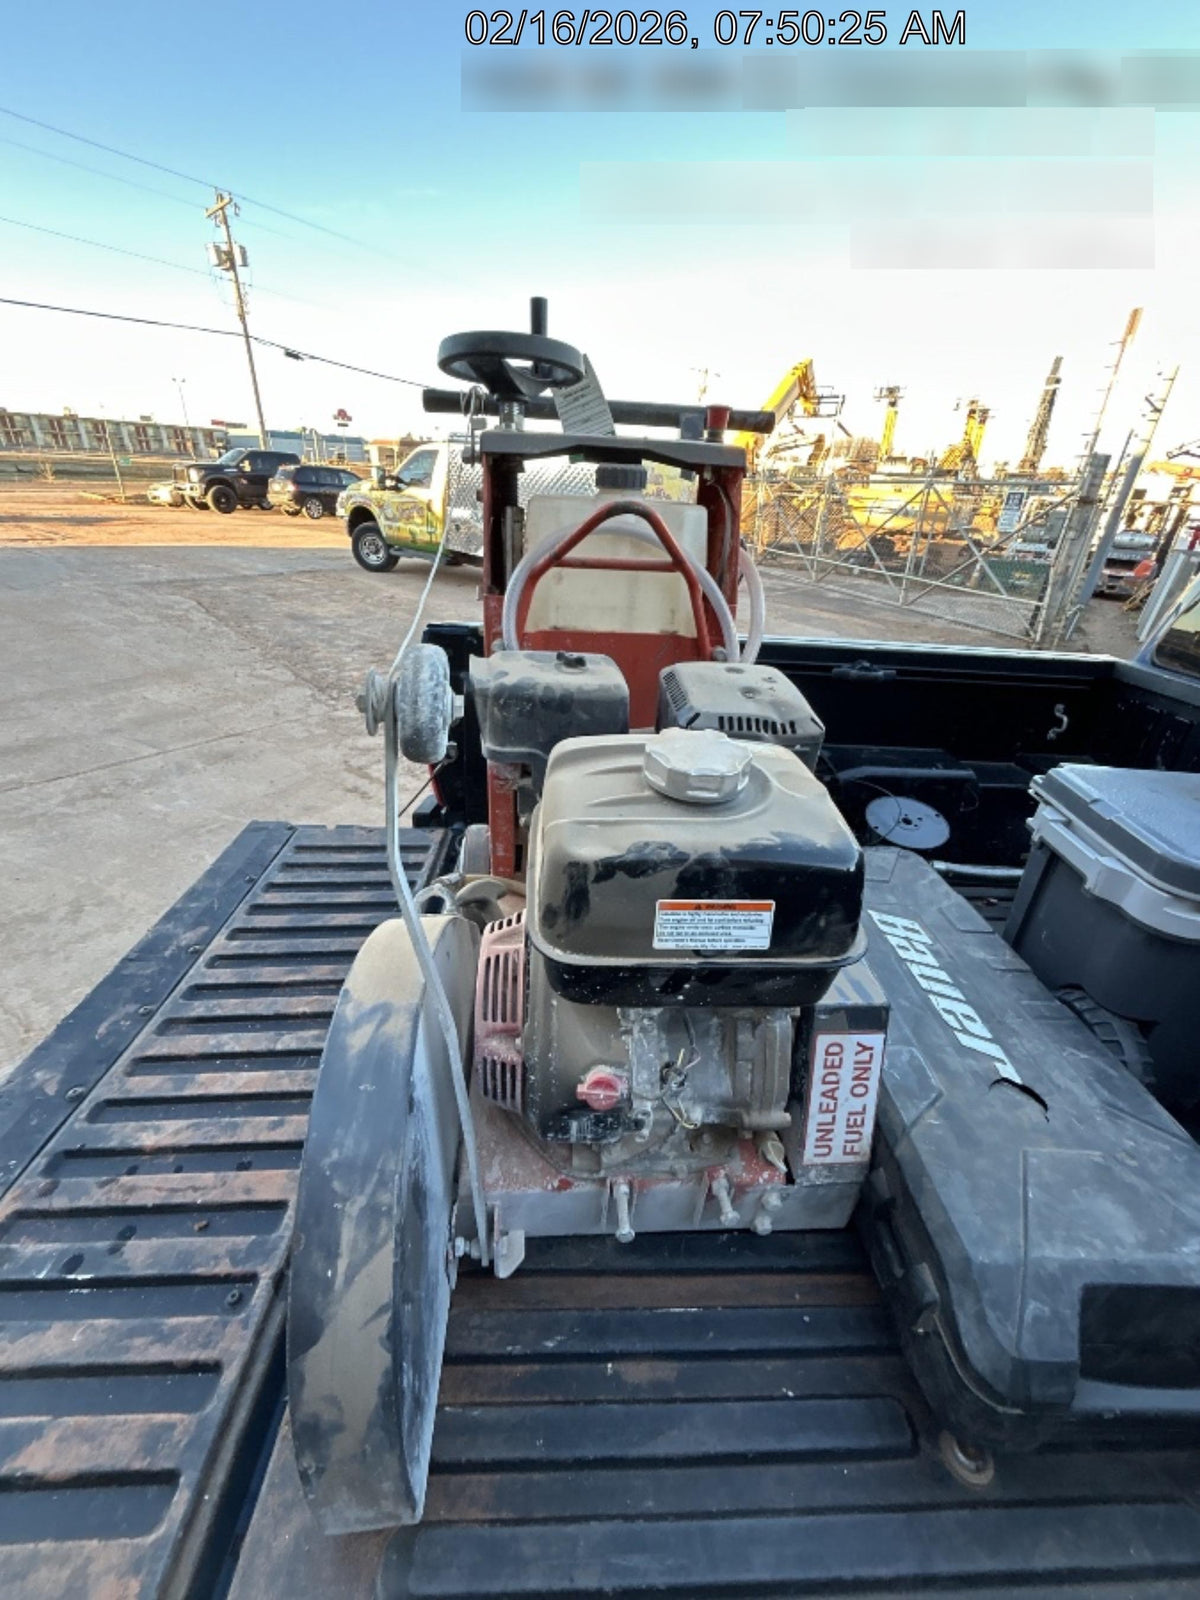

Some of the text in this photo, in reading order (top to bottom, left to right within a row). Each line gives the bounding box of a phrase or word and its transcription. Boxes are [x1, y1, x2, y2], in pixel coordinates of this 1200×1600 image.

[814, 1041, 845, 1157] UNLEADED
[842, 1041, 875, 1156] FUEL ONLY
